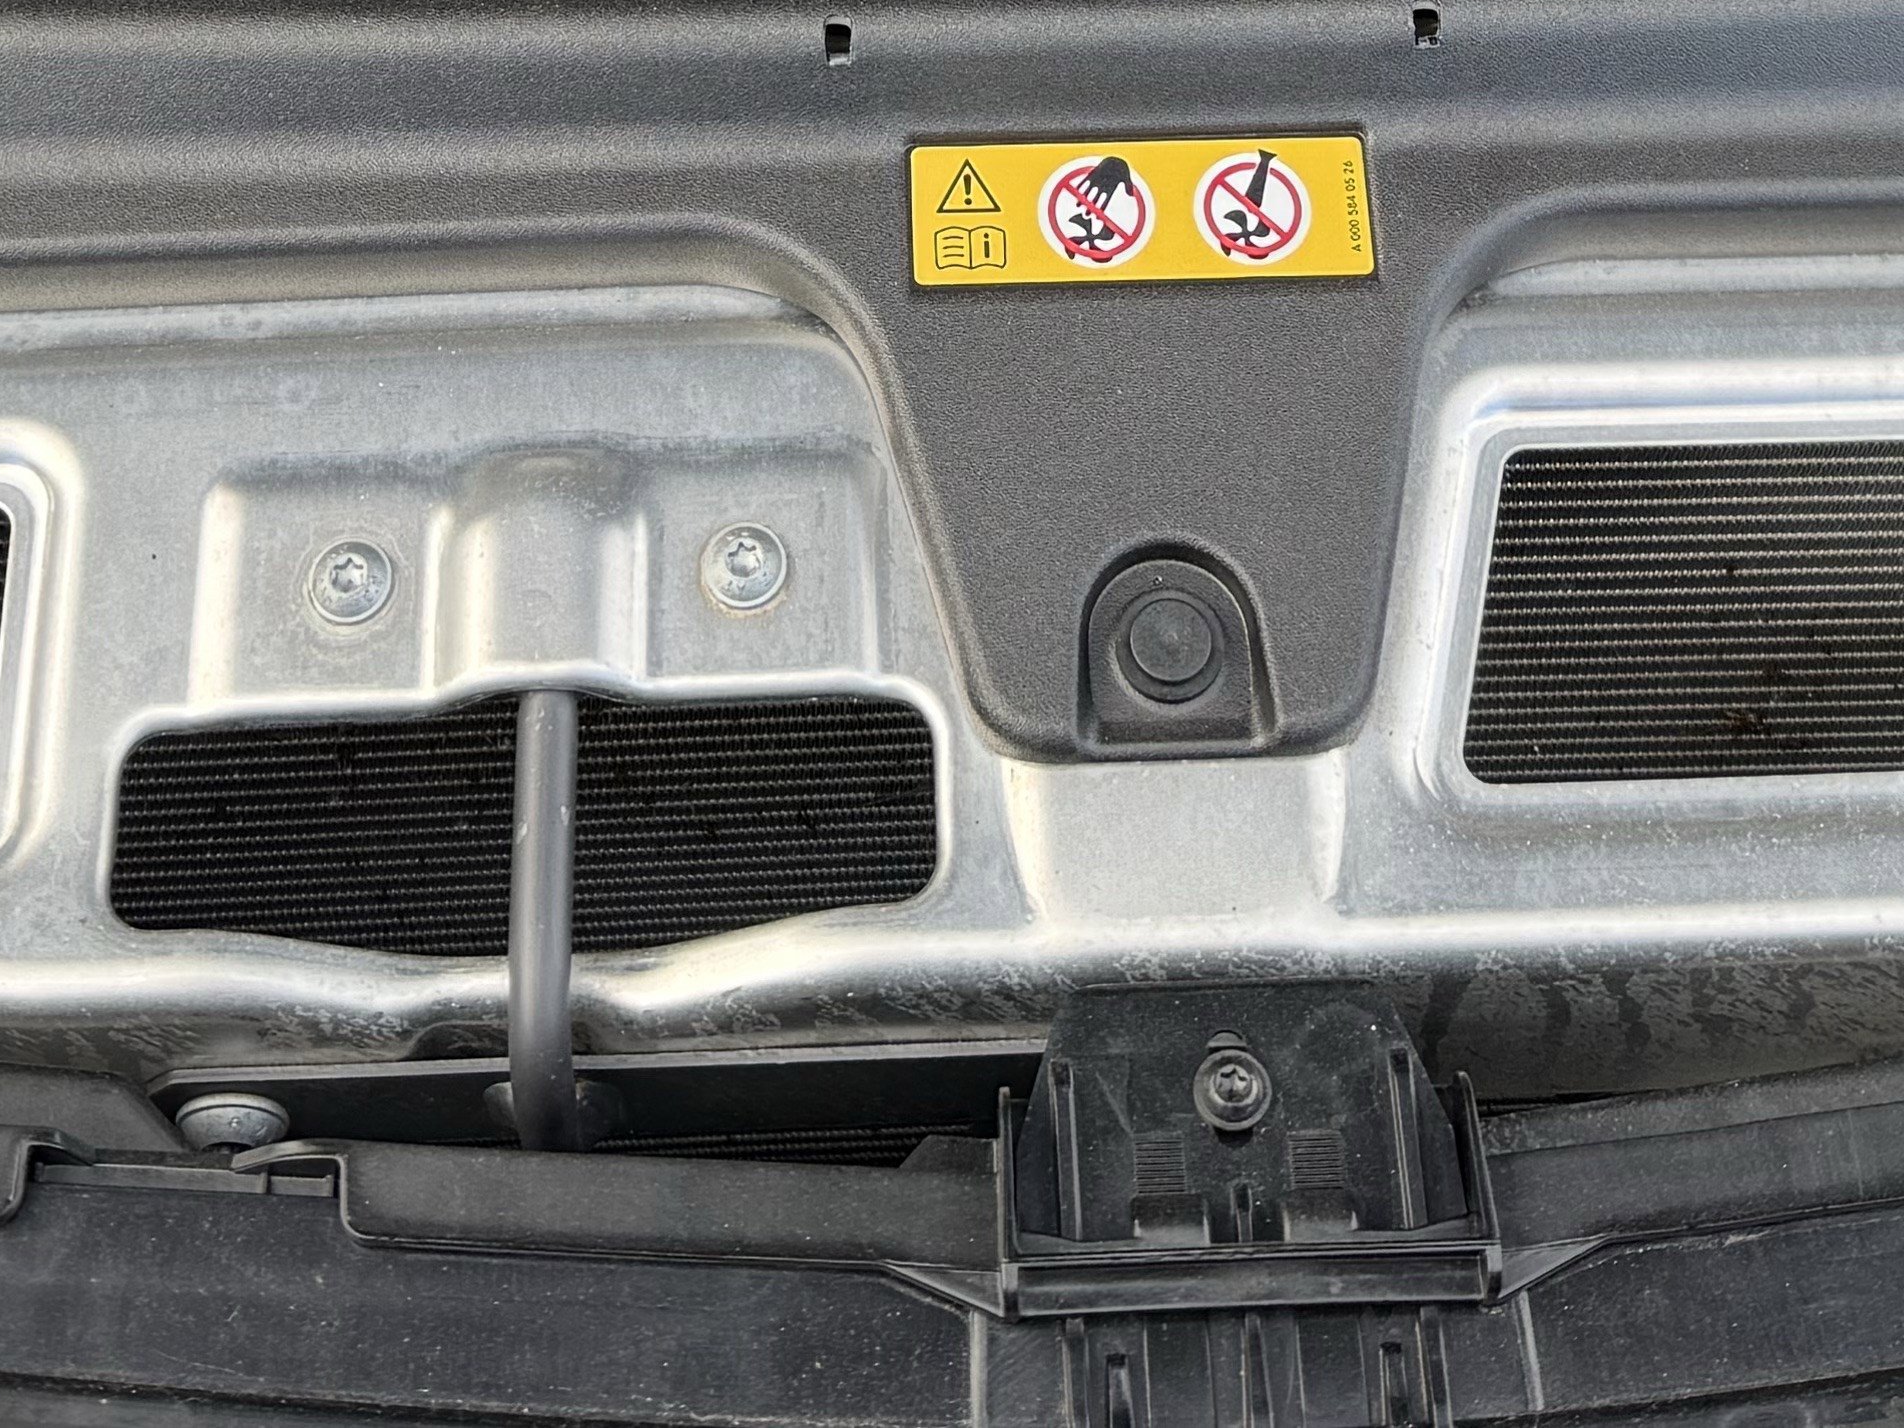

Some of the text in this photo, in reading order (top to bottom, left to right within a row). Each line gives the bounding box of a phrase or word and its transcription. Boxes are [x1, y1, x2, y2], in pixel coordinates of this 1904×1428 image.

[1342, 160, 1355, 175] 26
[1343, 177, 1356, 192] 05
[1348, 219, 1361, 242] 000
[1350, 243, 1362, 253] A
